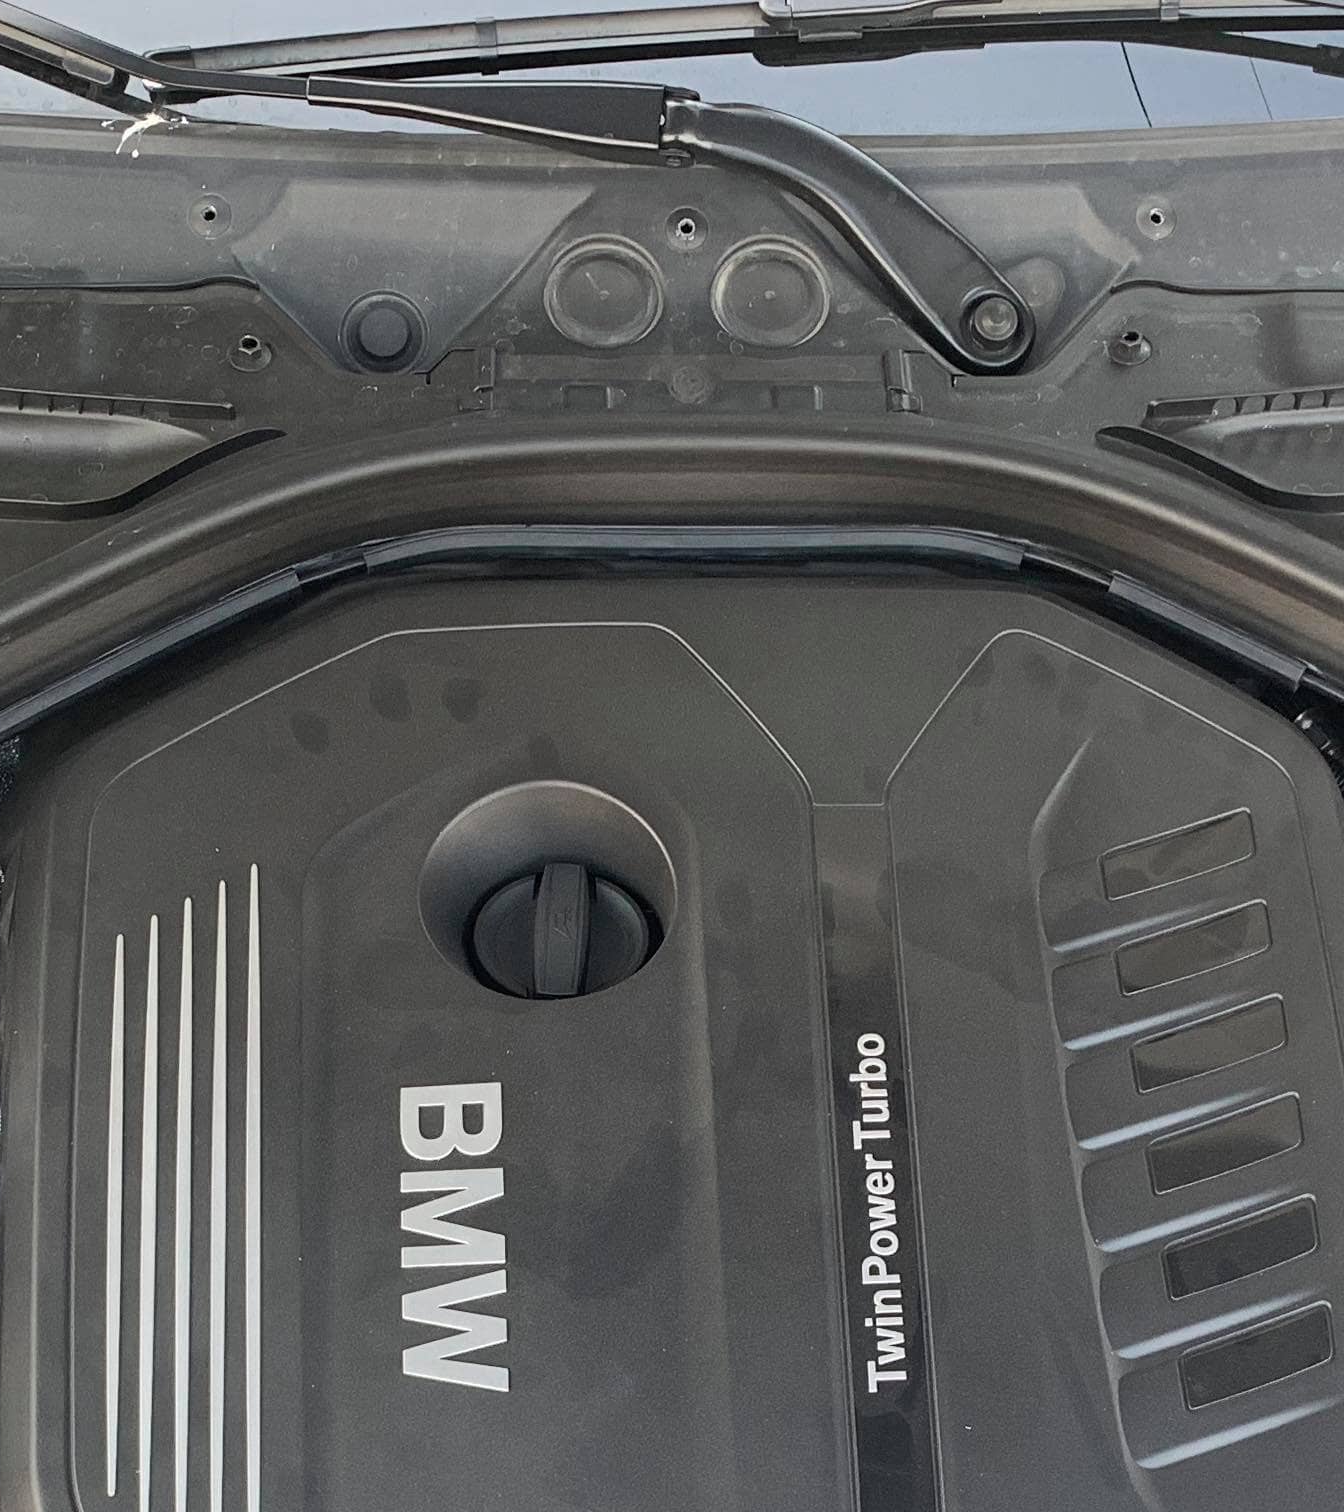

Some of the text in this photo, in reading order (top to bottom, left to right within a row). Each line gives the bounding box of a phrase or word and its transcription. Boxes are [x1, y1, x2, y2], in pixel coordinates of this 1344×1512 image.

[400, 1081, 510, 1393] BMW
[849, 1032, 908, 1394] TwinPower Turbo
